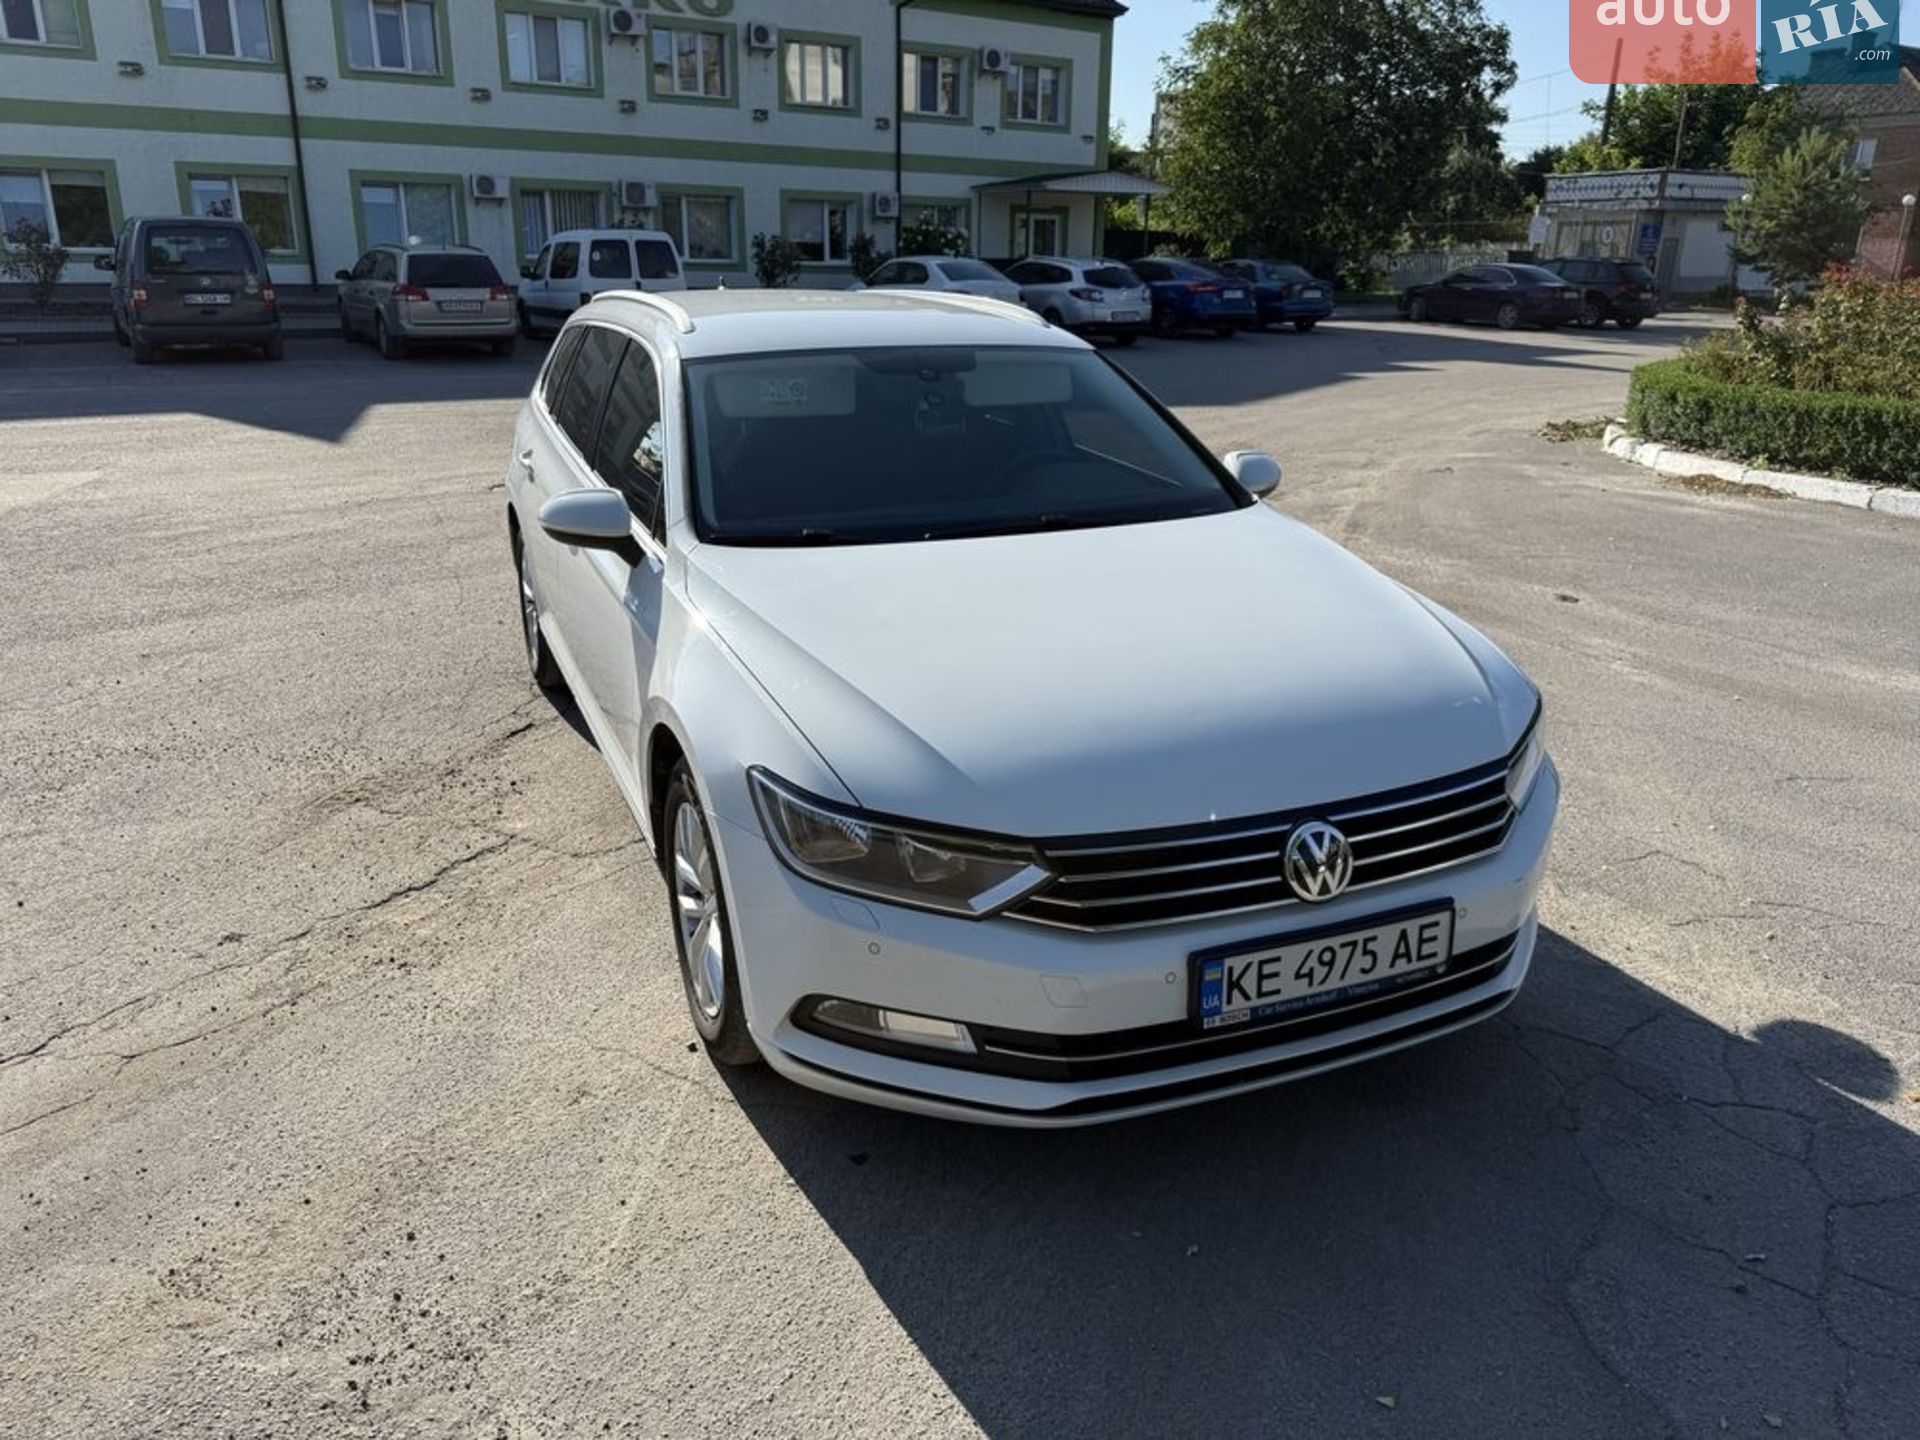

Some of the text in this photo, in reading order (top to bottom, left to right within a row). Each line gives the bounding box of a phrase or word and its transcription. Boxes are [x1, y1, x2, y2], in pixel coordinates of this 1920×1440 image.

[1226, 920, 1441, 1006] KE 4975 AE
[1203, 995, 1220, 1011] UA
